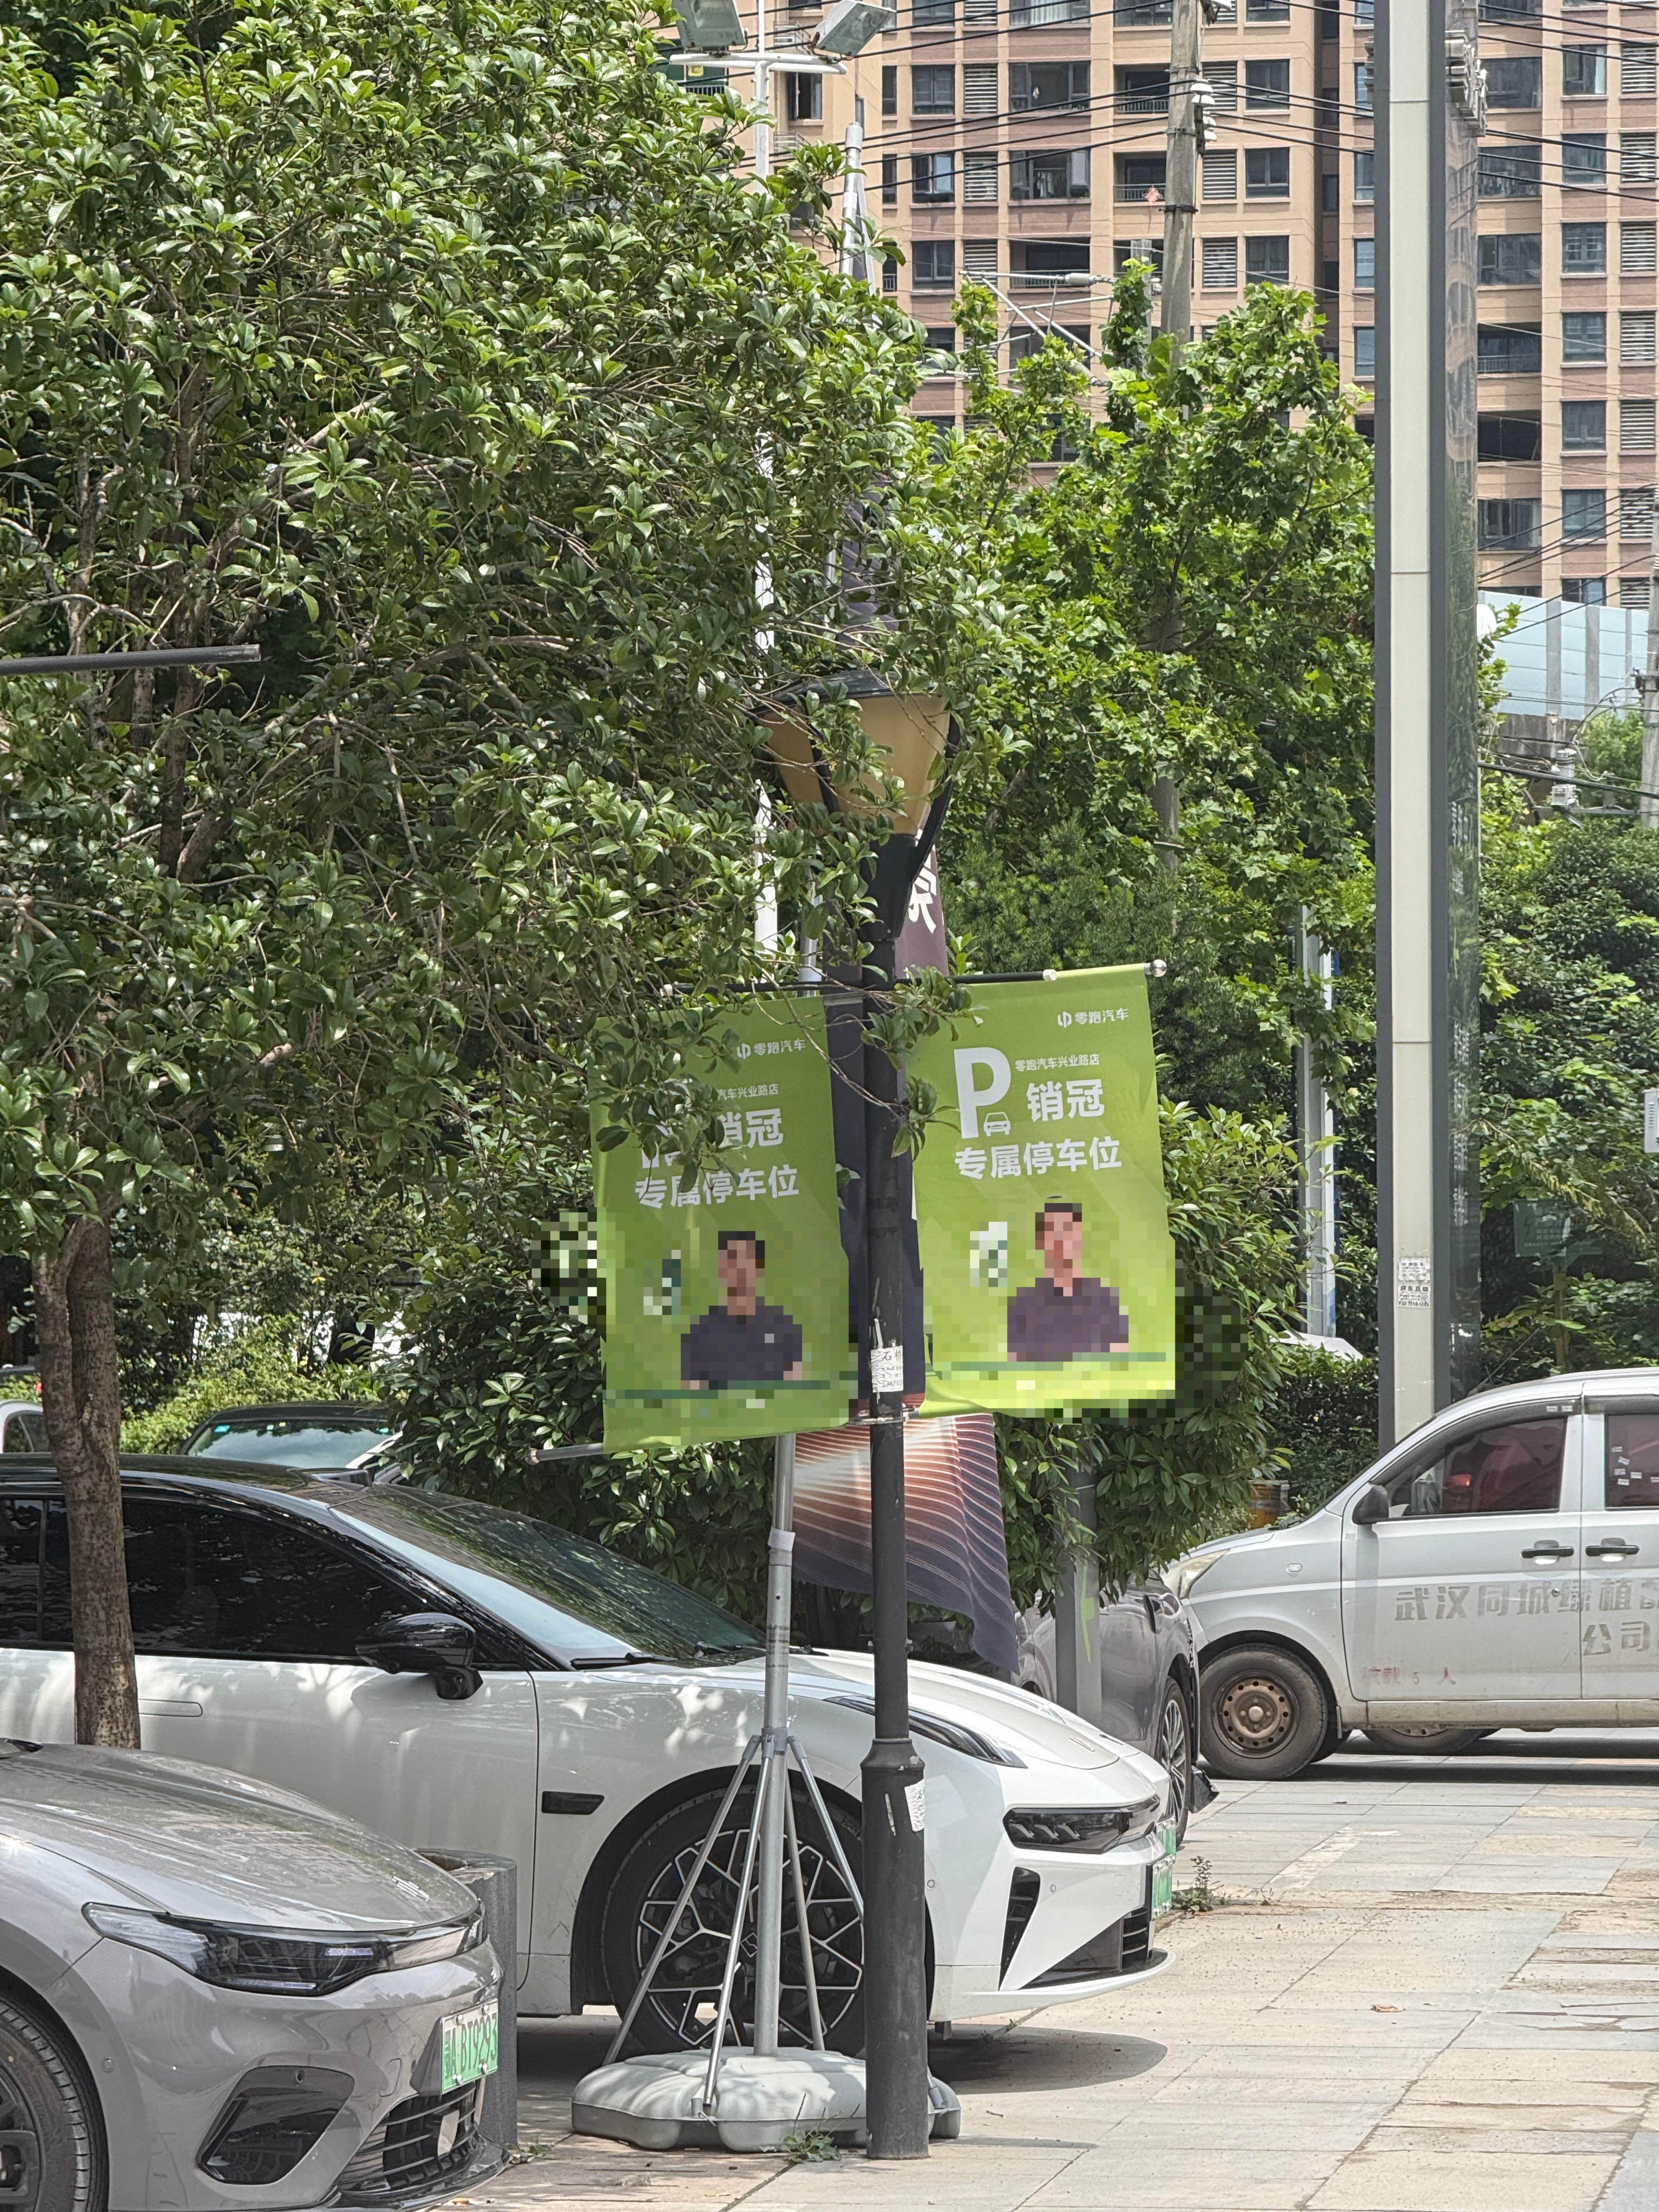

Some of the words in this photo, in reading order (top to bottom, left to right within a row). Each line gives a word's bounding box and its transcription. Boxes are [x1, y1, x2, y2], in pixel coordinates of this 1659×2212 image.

[1074, 1008, 1129, 1025] 零跑汽车
[753, 1039, 806, 1056] 零跑汽车
[1015, 1053, 1100, 1071] 零跑汽车兴业路店
[716, 1083, 778, 1101] 汽车兴业路店
[954, 1047, 1011, 1139] P
[1026, 1078, 1105, 1122] 销冠
[955, 1136, 1122, 1180] 专属停车位
[634, 1164, 799, 1209] 专属停车位
[1582, 1621, 1659, 1656] 公司
